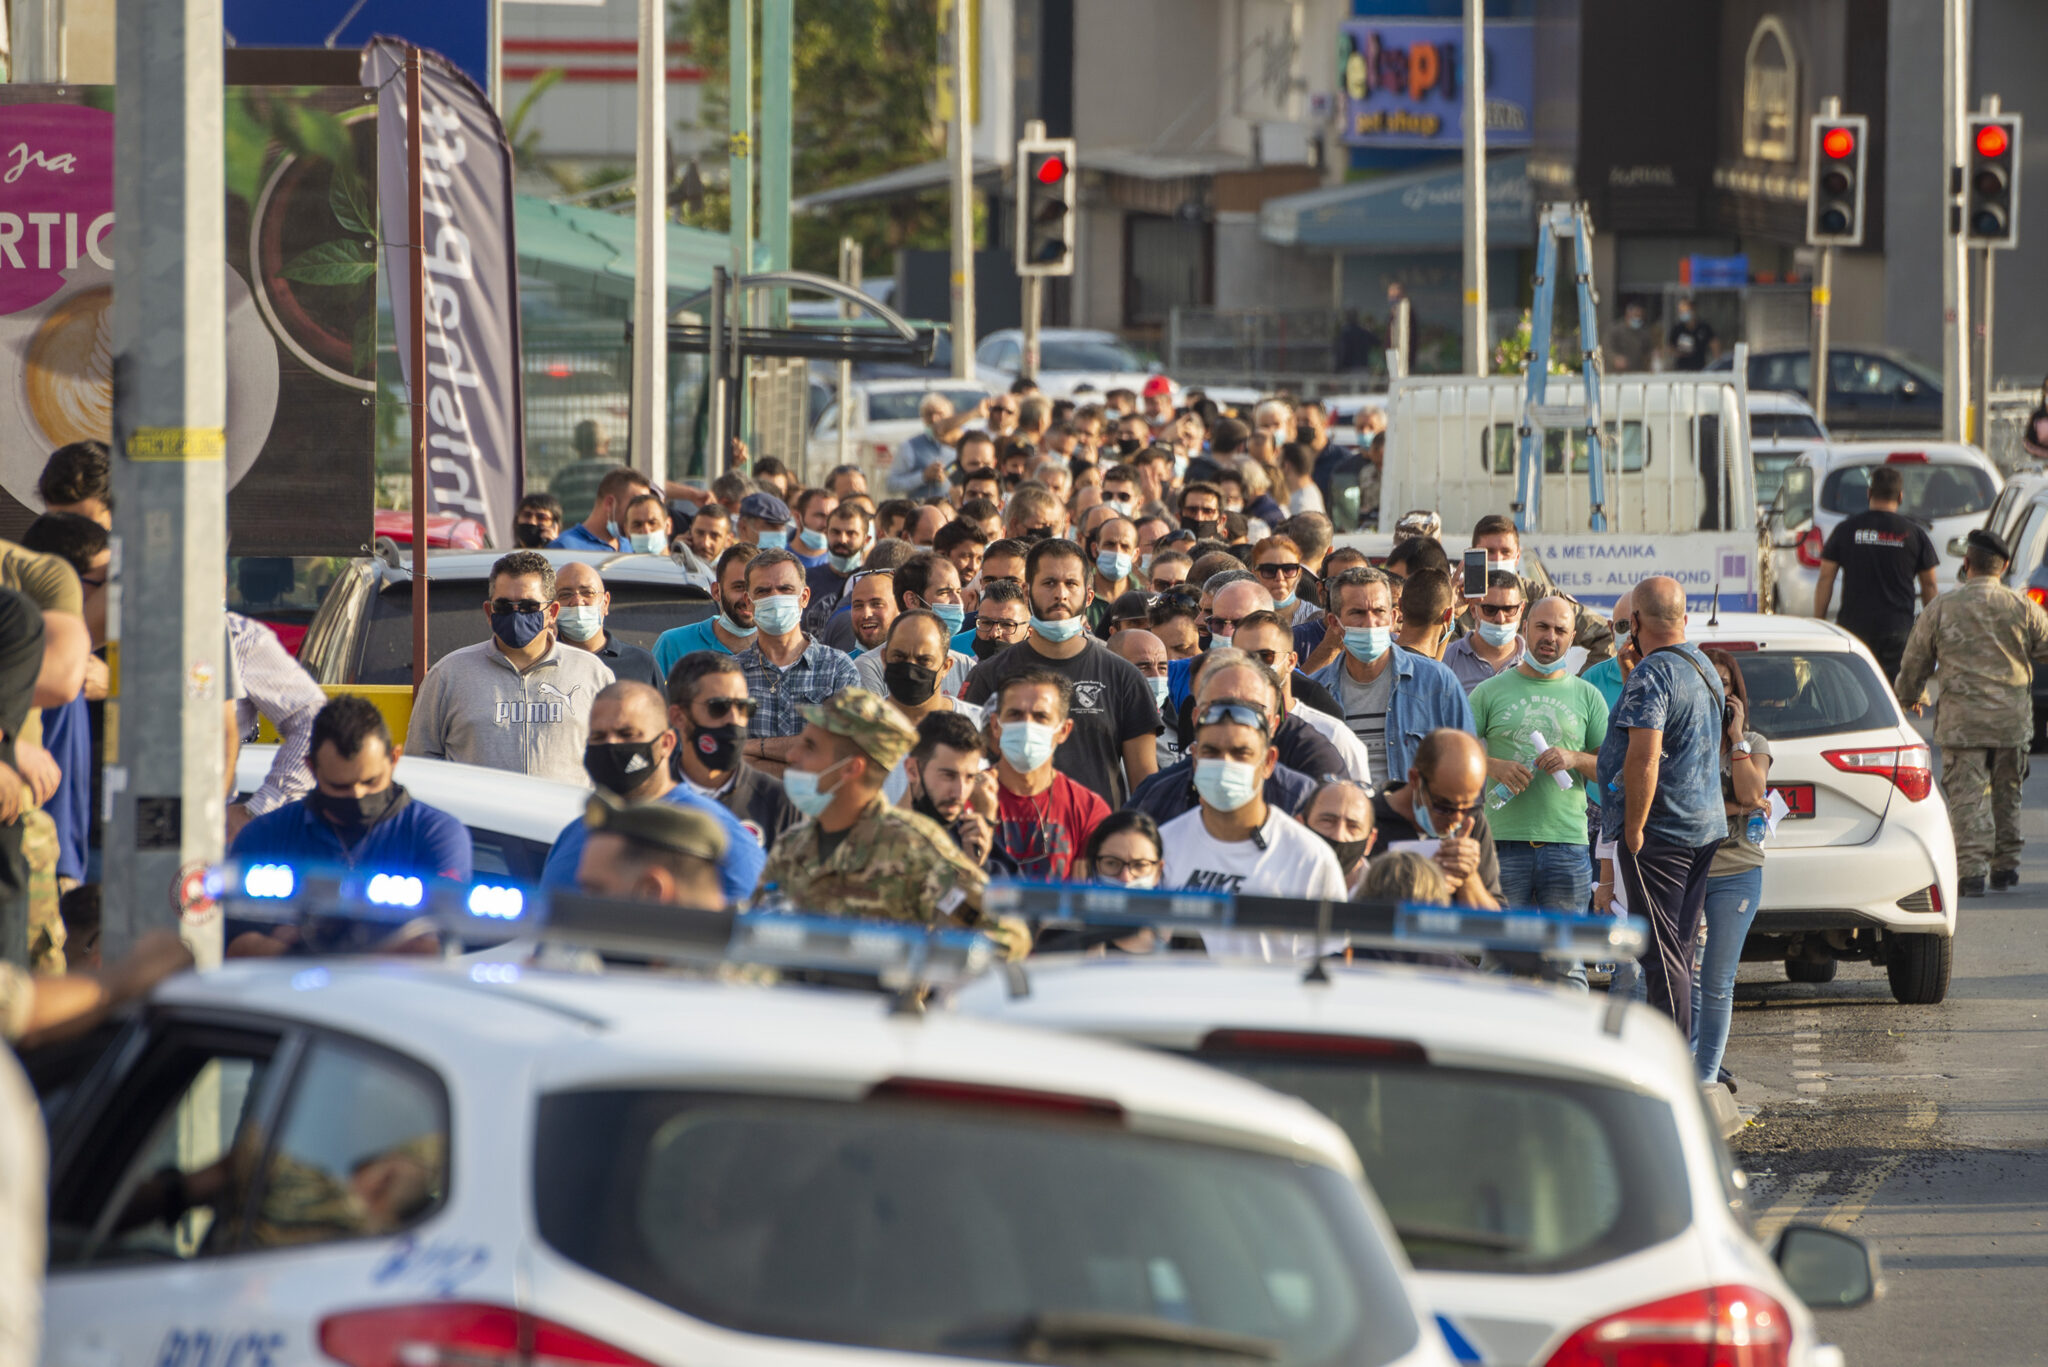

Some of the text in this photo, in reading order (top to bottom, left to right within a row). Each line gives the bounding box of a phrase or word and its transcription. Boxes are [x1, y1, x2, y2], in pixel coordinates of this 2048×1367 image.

[1546, 545, 1558, 559] &
[494, 701, 563, 724] PUMA
[1182, 869, 1247, 894] NIKE
